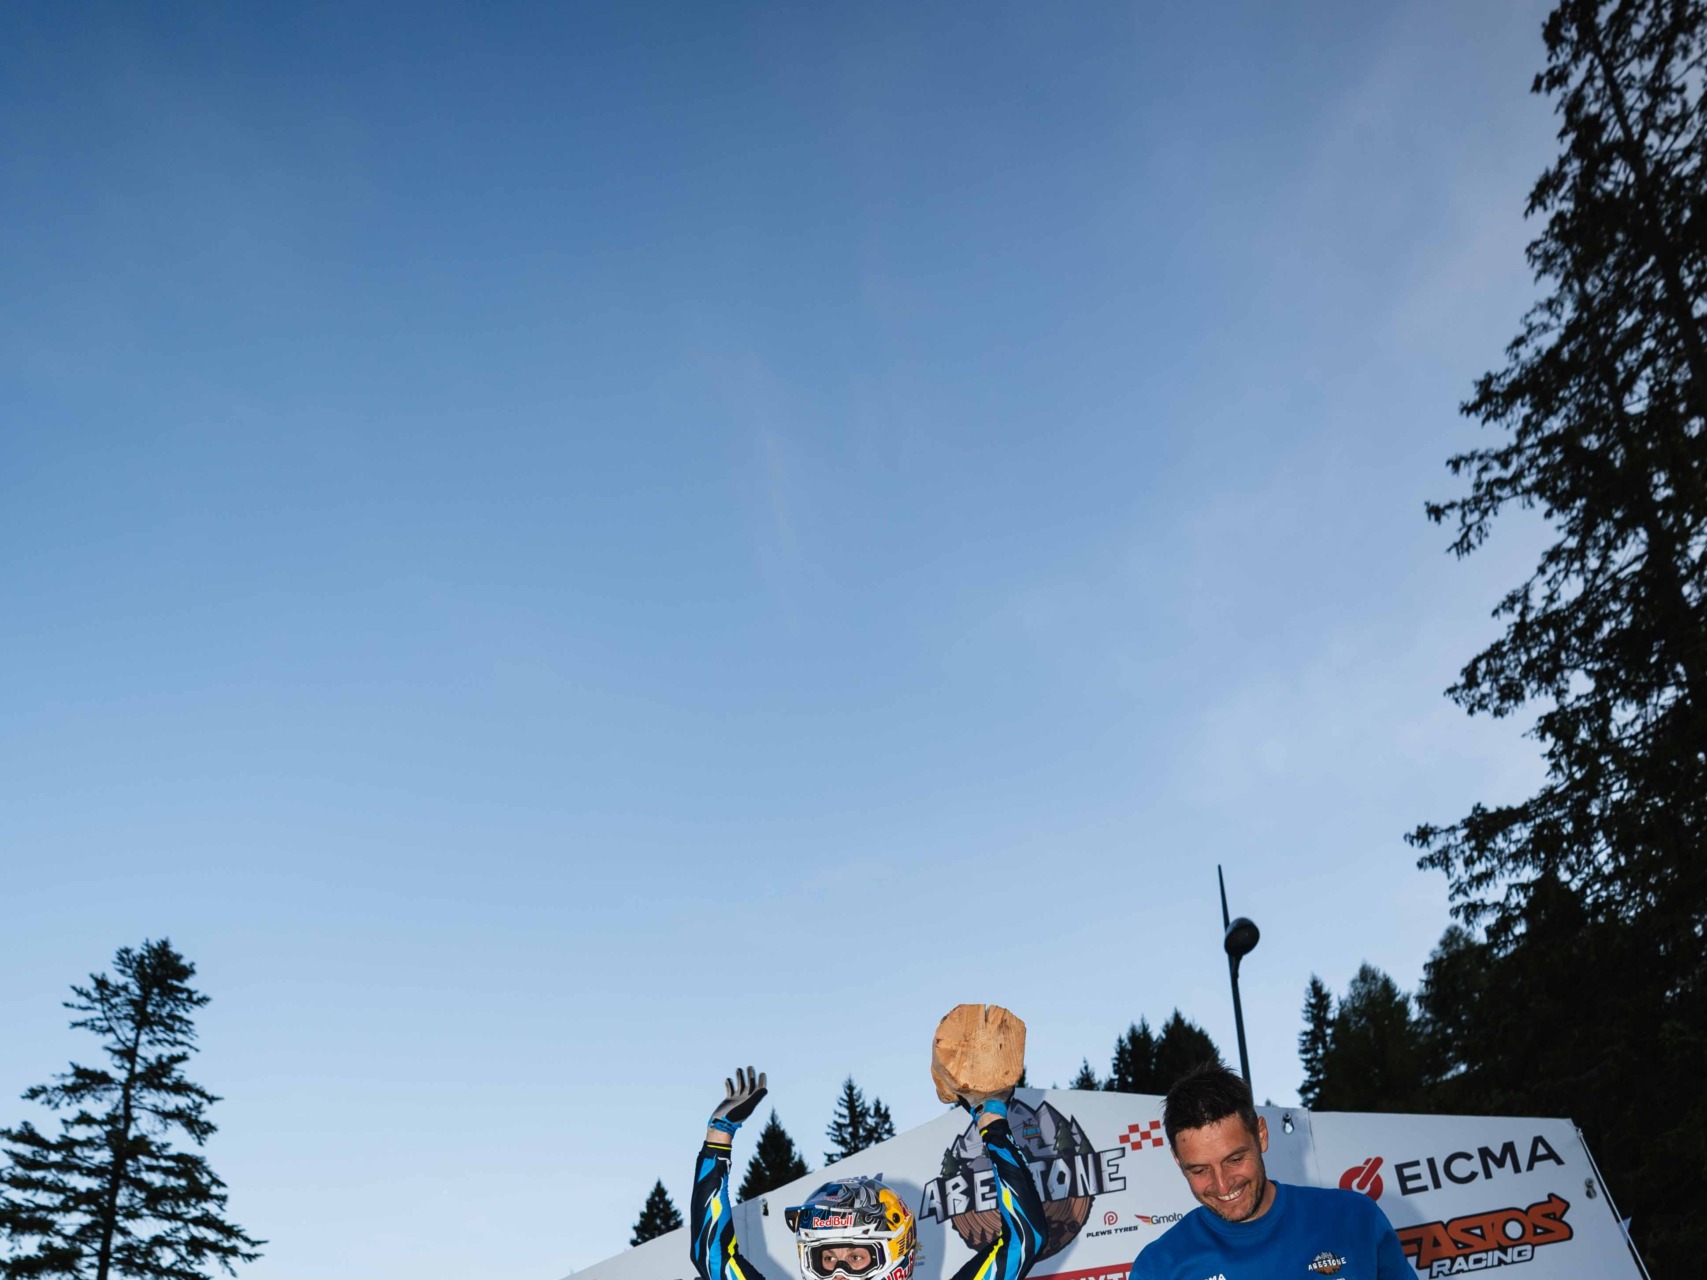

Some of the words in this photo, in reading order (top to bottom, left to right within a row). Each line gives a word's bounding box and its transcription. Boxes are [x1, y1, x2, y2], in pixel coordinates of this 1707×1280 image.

[918, 1147, 1127, 1224] ABETONE
[1394, 1135, 1565, 1196] EICMA
[1086, 1229, 1112, 1238] PLEWS
[1114, 1225, 1139, 1234] TYRES
[1429, 1244, 1535, 1279] RACING
